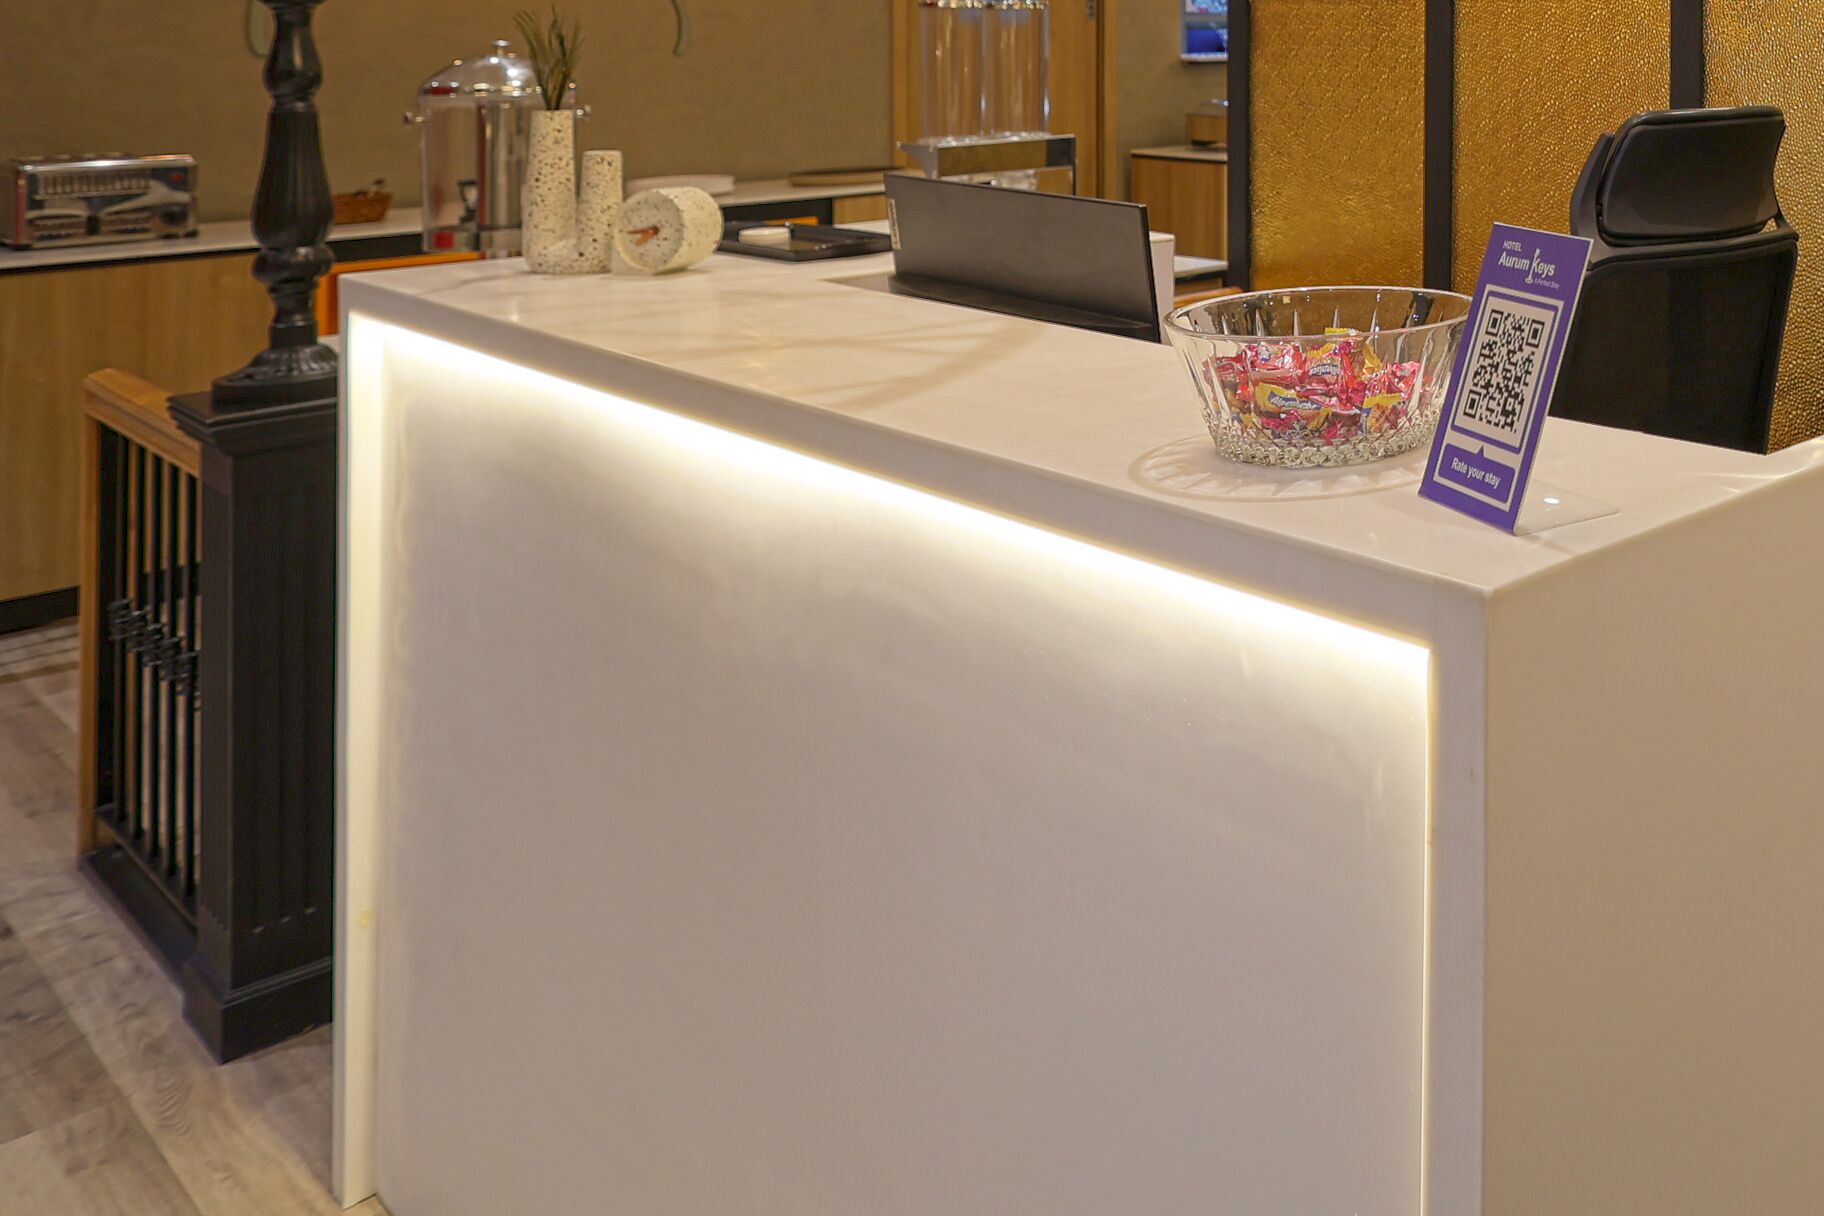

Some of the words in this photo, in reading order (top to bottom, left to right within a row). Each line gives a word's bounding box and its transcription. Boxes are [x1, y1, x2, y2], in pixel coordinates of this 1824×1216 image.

[1502, 240, 1522, 252] HOTEL
[1498, 251, 1530, 271] Aurum
[1528, 249, 1556, 281] Keys
[1451, 457, 1468, 474] Rate
[1466, 466, 1485, 479] your
[1484, 472, 1501, 489] stay
